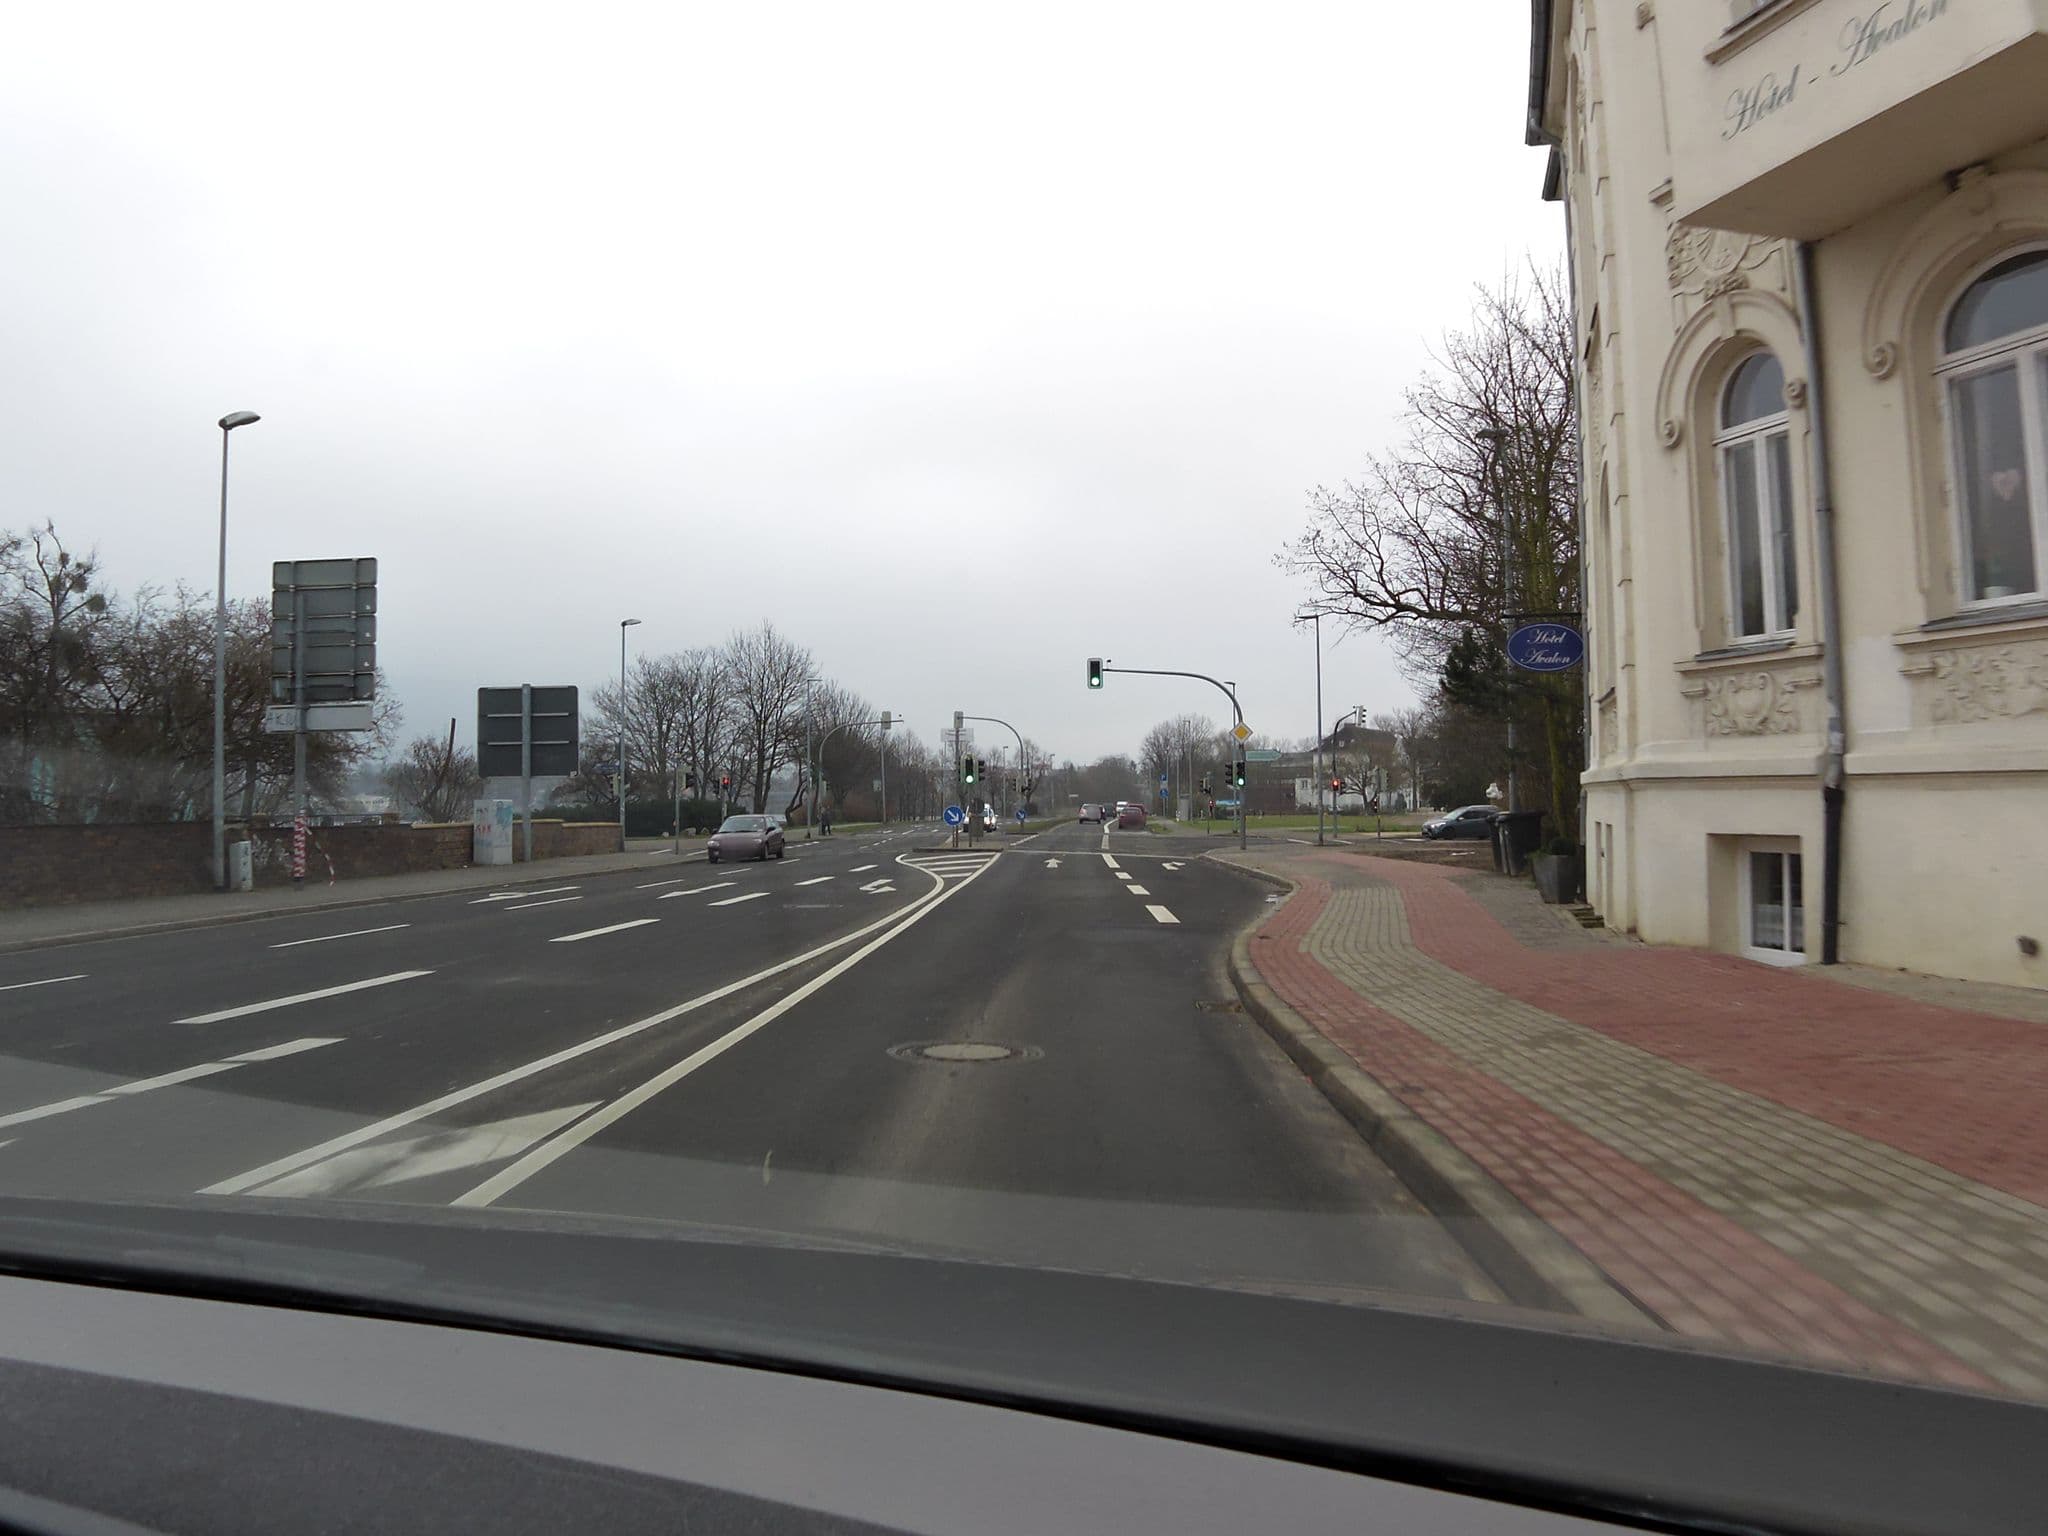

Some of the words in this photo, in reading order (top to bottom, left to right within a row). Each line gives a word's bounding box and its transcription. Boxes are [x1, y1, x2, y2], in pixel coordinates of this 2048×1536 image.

[1722, 64, 1800, 140] Hotel
[1527, 629, 1567, 645] Hotel
[1520, 649, 1570, 664] Avalon
